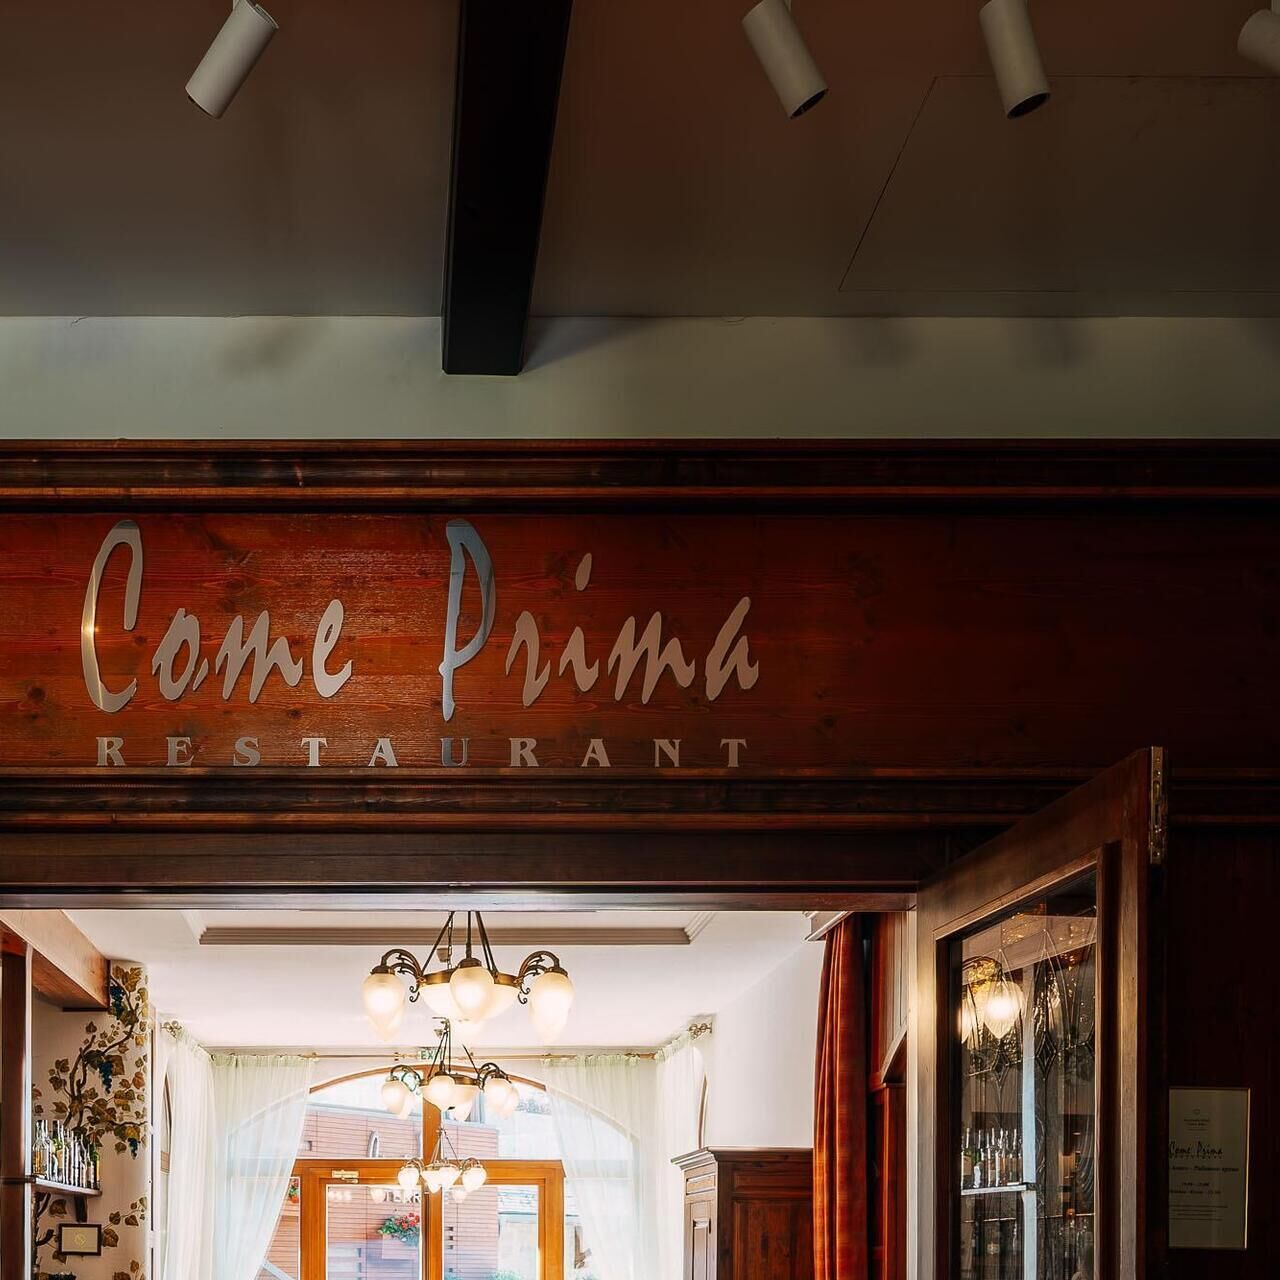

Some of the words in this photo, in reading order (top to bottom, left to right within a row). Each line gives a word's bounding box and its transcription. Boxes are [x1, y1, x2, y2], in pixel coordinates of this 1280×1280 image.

[81, 520, 353, 713] Come
[438, 519, 760, 721] Prima
[96, 736, 750, 768] RESTAURANT
